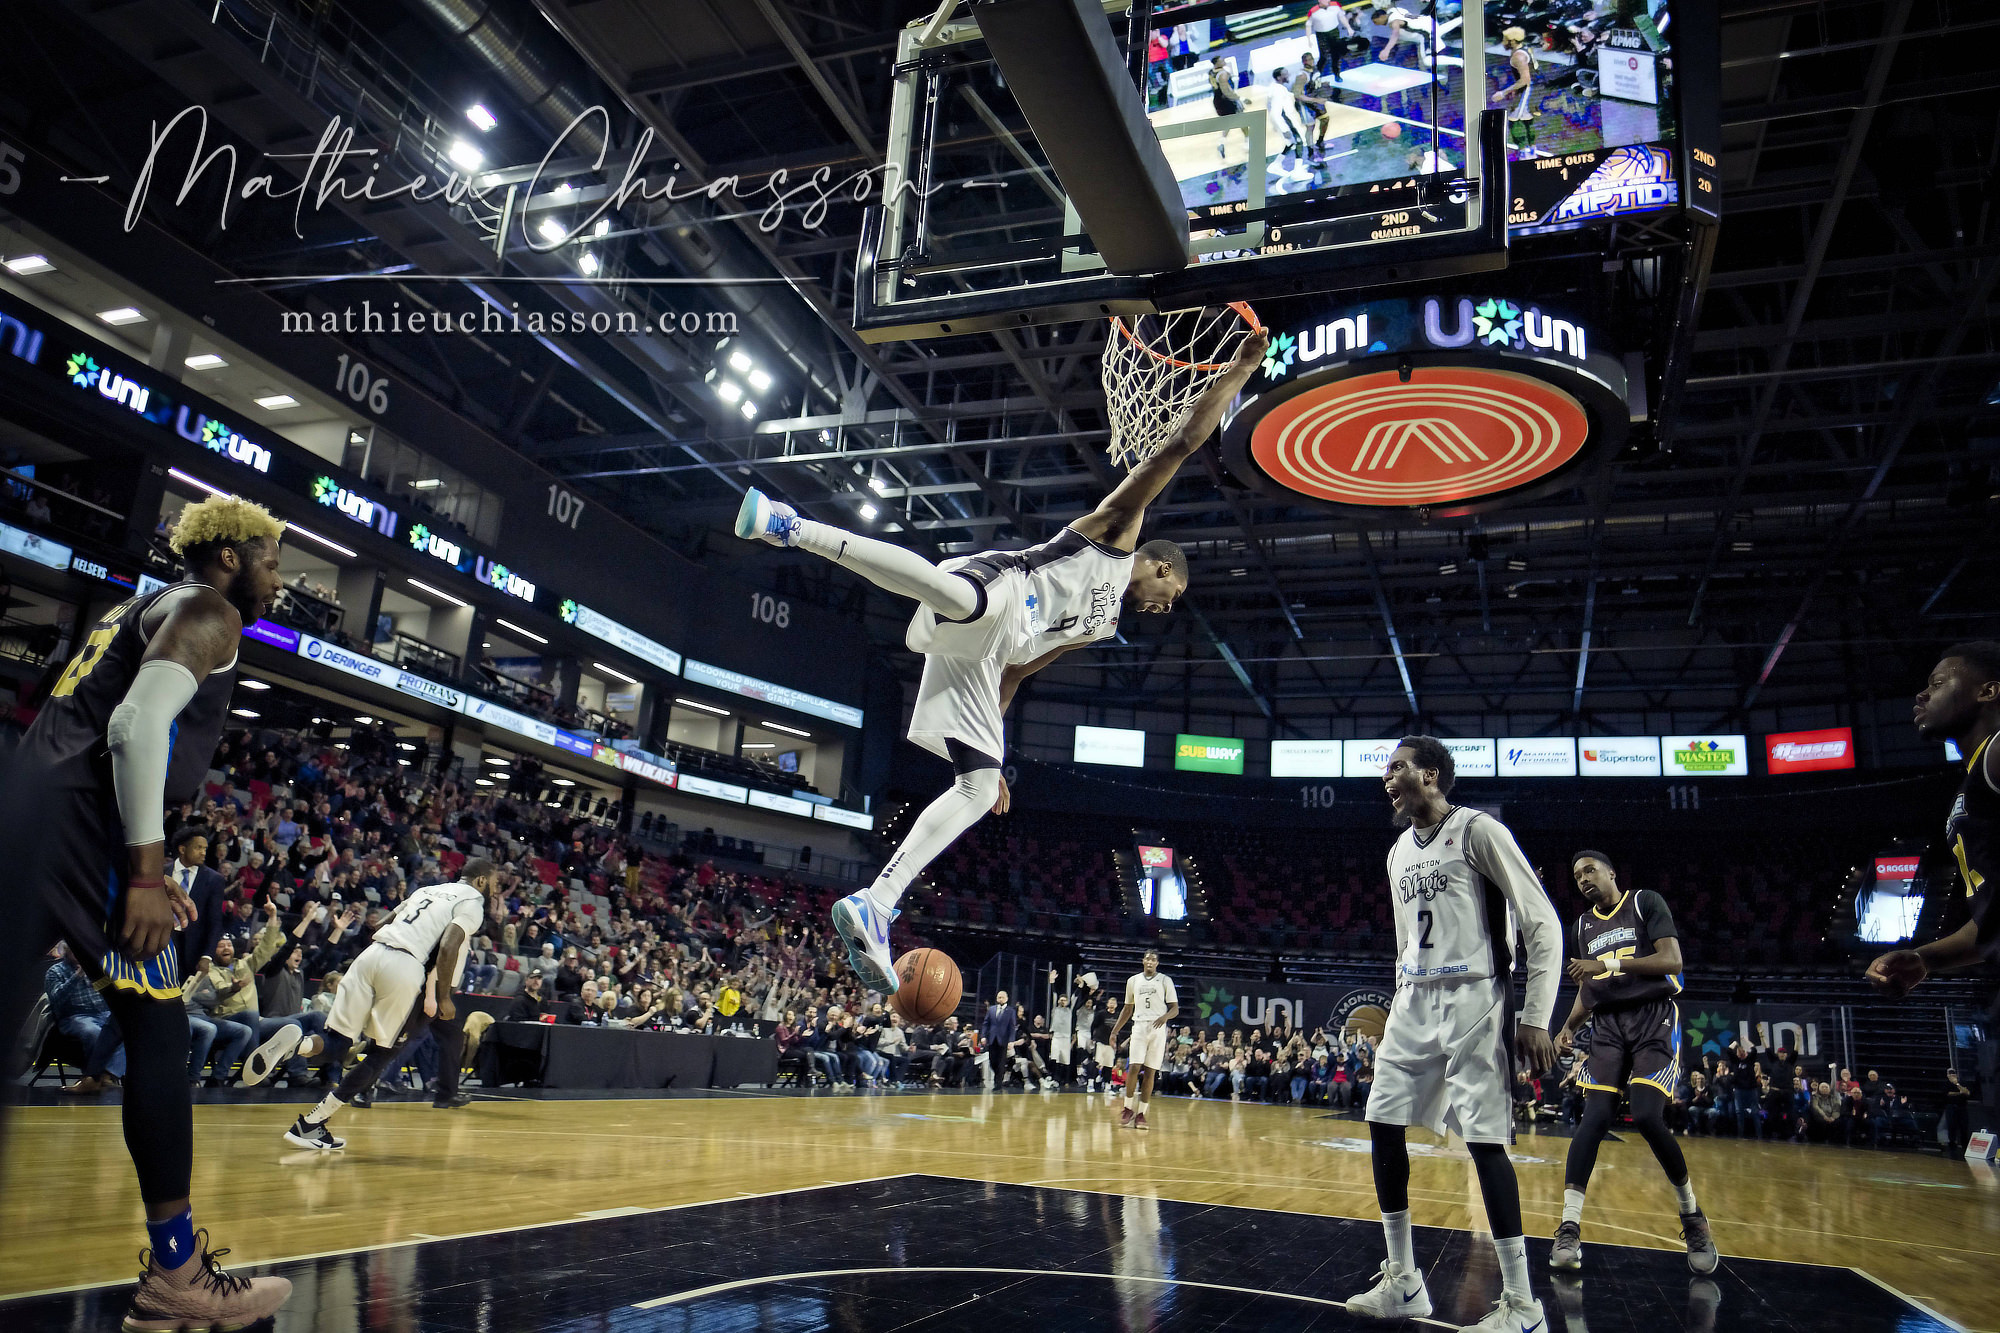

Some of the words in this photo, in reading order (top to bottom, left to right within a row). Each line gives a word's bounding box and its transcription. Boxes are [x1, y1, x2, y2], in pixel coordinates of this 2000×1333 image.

[1534, 157, 1562, 170] TIME
[1567, 153, 1595, 166] OUTS
[1693, 148, 1716, 167] 2ND
[0, 141, 25, 195] 5
[1560, 168, 1568, 181] 1
[1698, 177, 1712, 193] 20
[1208, 204, 1233, 216] TIME
[1235, 202, 1249, 212] OU
[1513, 198, 1525, 211] 2
[1558, 182, 1678, 219] RIPTIDE
[1381, 211, 1409, 226] 2ND
[1508, 211, 1538, 224] OULS
[1271, 228, 1281, 242] 0
[1371, 225, 1421, 240] QUARTER
[336, 353, 389, 415] 106
[548, 484, 585, 530] 107
[751, 592, 790, 629] 108
[323, 649, 381, 678] DERINGER
[399, 672, 458, 707] PROTRANS
[686, 661, 742, 684] MACDONALD
[743, 677, 770, 692] BUICK
[771, 687, 791, 698] GMC
[791, 691, 830, 709] CADILLAC
[715, 679, 740, 692] YOUR
[767, 693, 796, 707] GIANT
[1178, 745, 1242, 760] SUBWAY
[1359, 753, 1391, 762] IRVIN
[1600, 754, 1656, 764] Superstore
[1678, 752, 1731, 763] MASTER
[623, 755, 677, 786] WILDCATS
[1300, 785, 1335, 809] 110
[1667, 785, 1699, 810] 111
[1404, 859, 1441, 873] MONCTON
[1886, 864, 1918, 872] ROGERS
[1399, 870, 1447, 904] Magic
[1418, 910, 1434, 949] 2
[1587, 927, 1637, 954] RIPTIDE
[1407, 968, 1427, 976] BLUE
[1429, 965, 1469, 976] CROSS
[1145, 997, 1151, 1009] 5
[1338, 992, 1393, 1016] MONCTO
